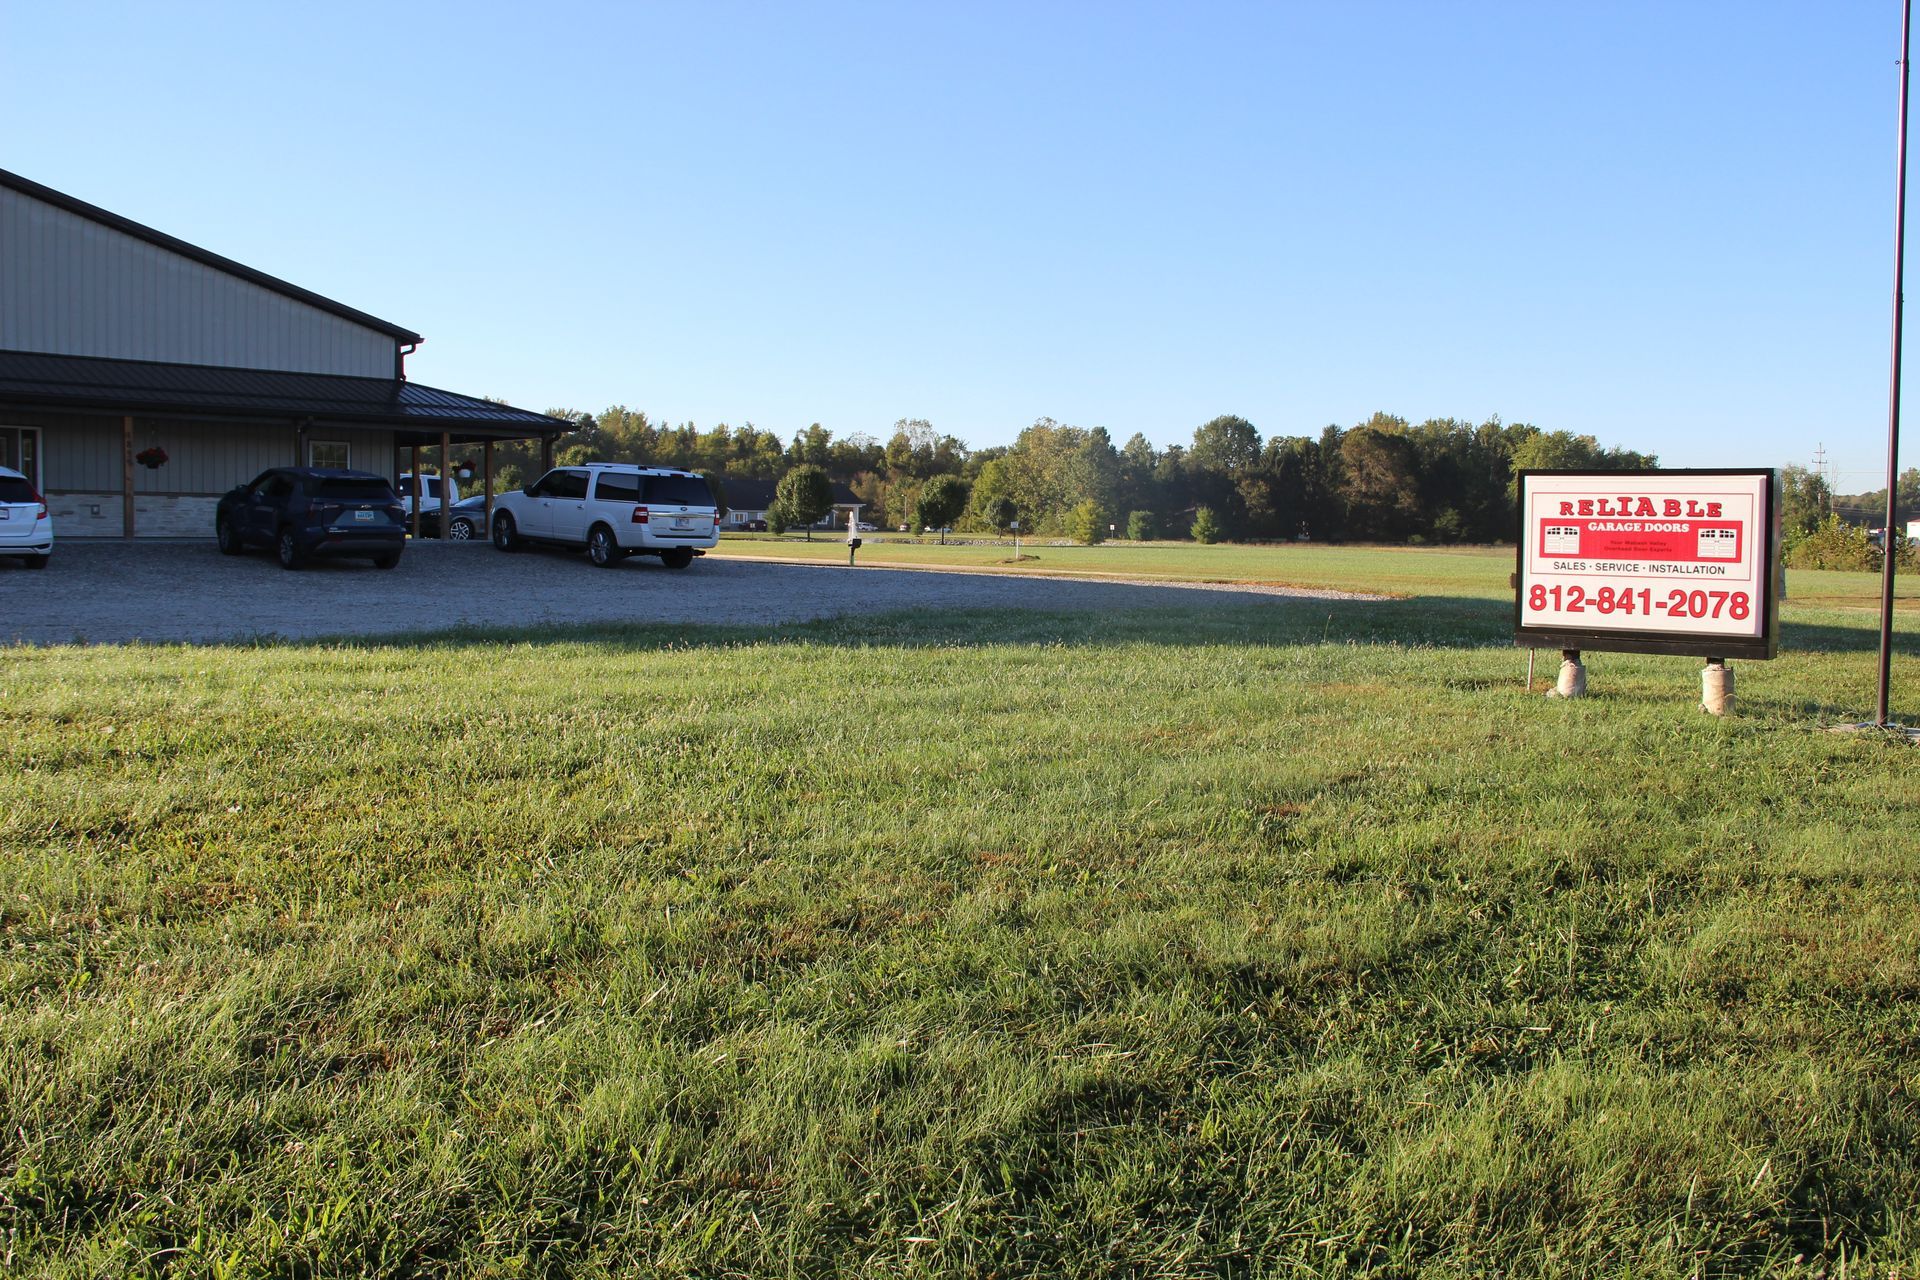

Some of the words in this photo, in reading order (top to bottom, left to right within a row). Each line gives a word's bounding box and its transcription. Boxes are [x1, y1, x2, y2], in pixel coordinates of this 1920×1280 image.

[1559, 496, 1722, 518] RELIABLE
[1588, 522, 1642, 532] GARAGE
[1643, 522, 1690, 533] DOORS
[1553, 561, 1586, 571] SALES
[1594, 562, 1639, 572] SERVICE
[1648, 564, 1725, 575] INSTALLATION
[1528, 584, 1750, 620] 812-841-2078
